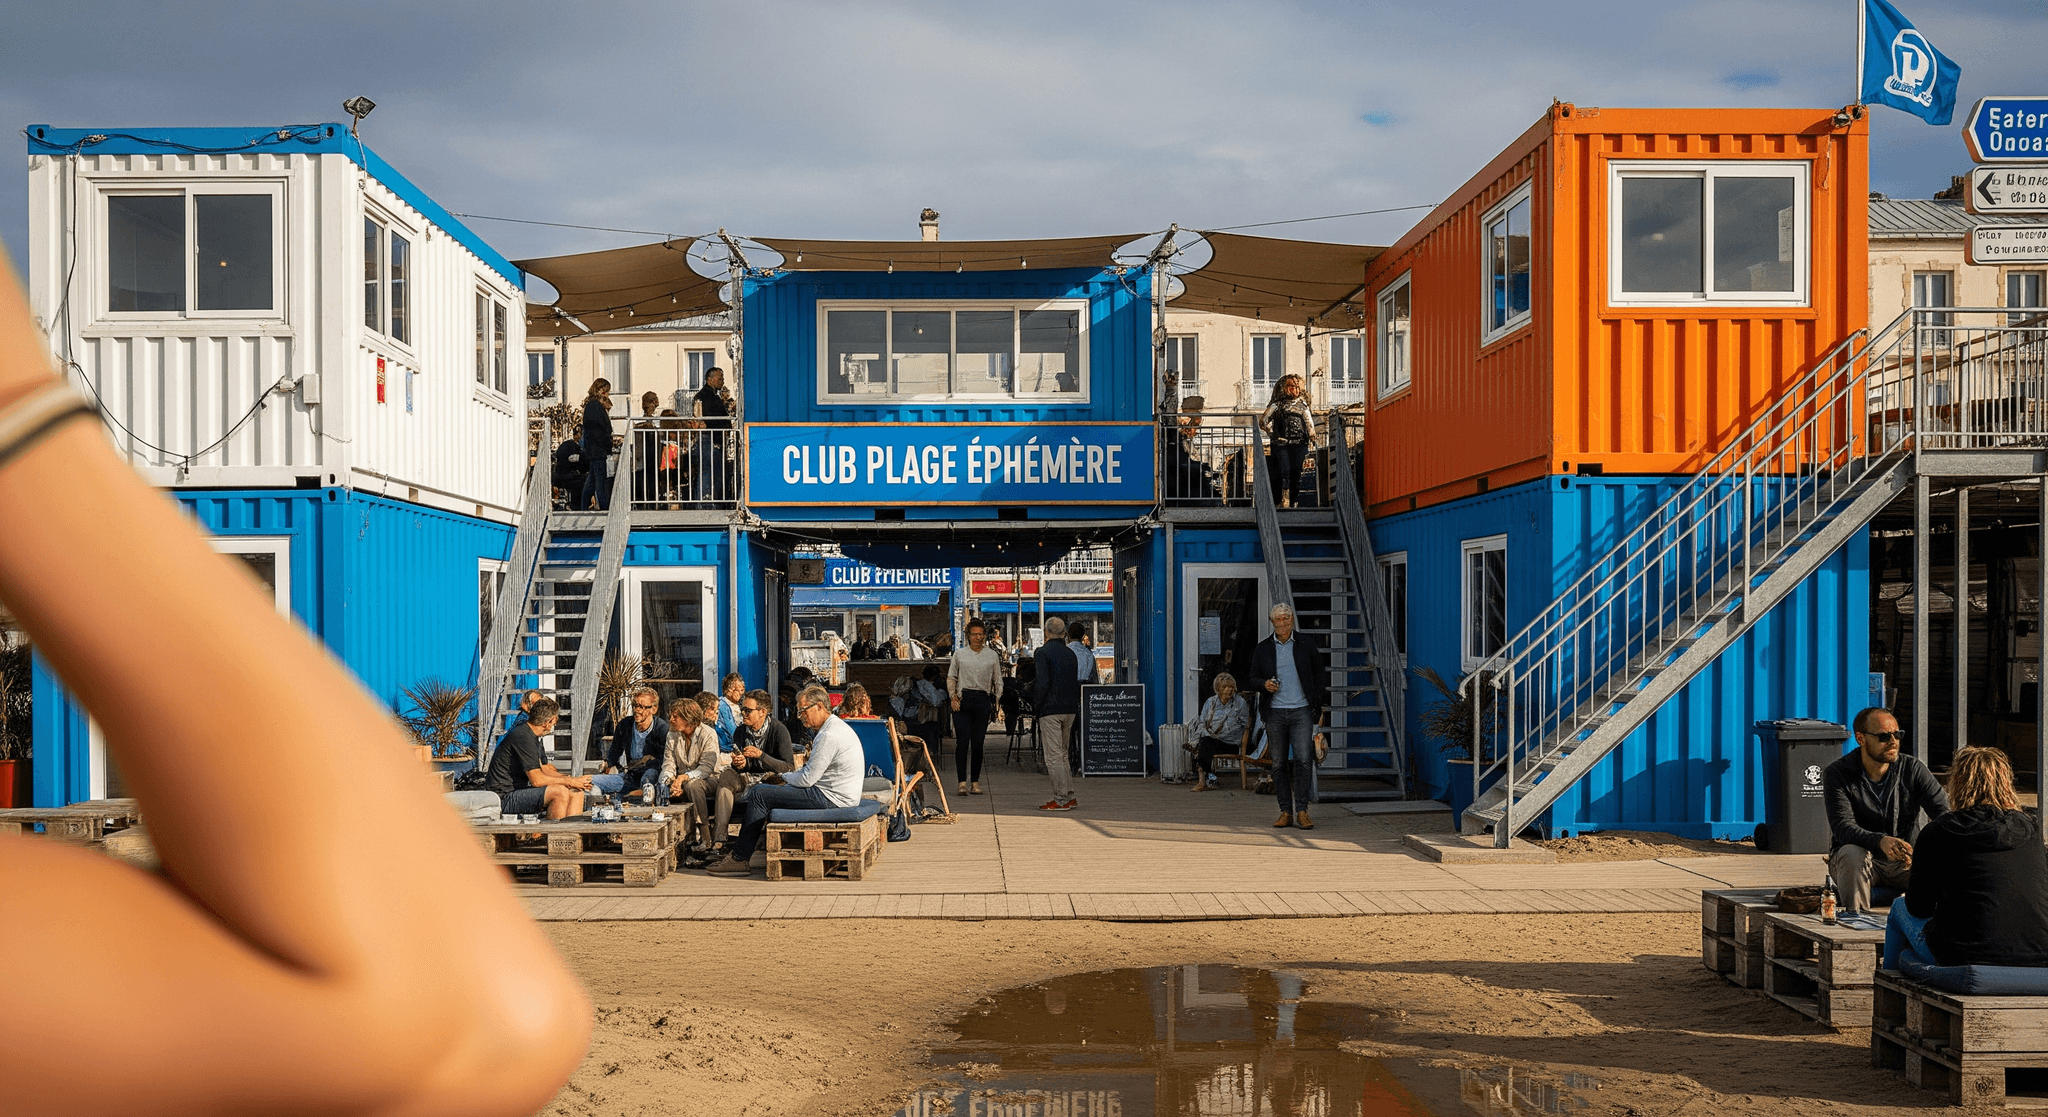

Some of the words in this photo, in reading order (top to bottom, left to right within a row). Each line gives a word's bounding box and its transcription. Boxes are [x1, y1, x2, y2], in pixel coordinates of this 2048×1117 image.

[782, 444, 857, 485] CLUB
[866, 444, 958, 485] PLAGE
[967, 435, 1122, 485] ÉPHÉMÈRE
[832, 566, 872, 585] CLUB
